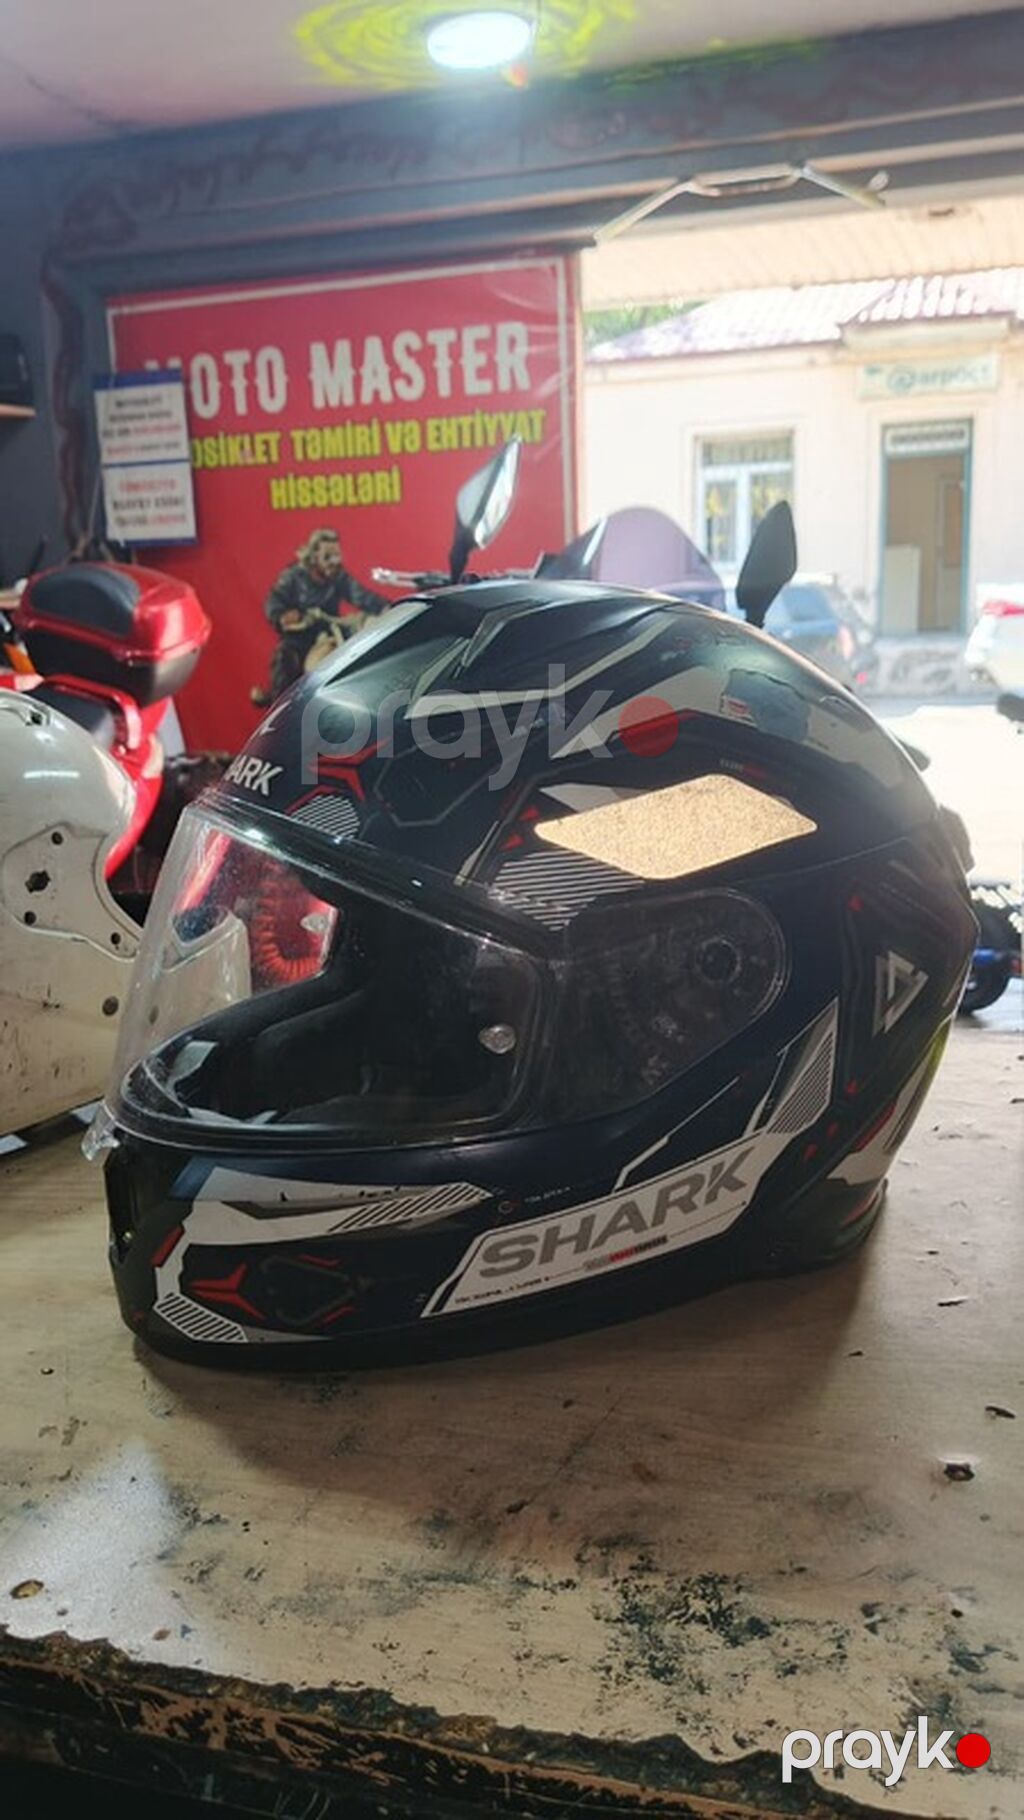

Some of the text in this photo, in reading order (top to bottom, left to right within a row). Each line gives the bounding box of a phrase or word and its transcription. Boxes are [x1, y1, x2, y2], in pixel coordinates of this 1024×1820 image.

[144, 321, 531, 419] OTO MASTER
[191, 408, 546, 469] OSİKLET TƏMİRİ VƏ EHTİYYAT
[270, 465, 402, 510] HİSSƏLƏRİ
[223, 754, 283, 796] ARK
[479, 1146, 755, 1279] SHARK
